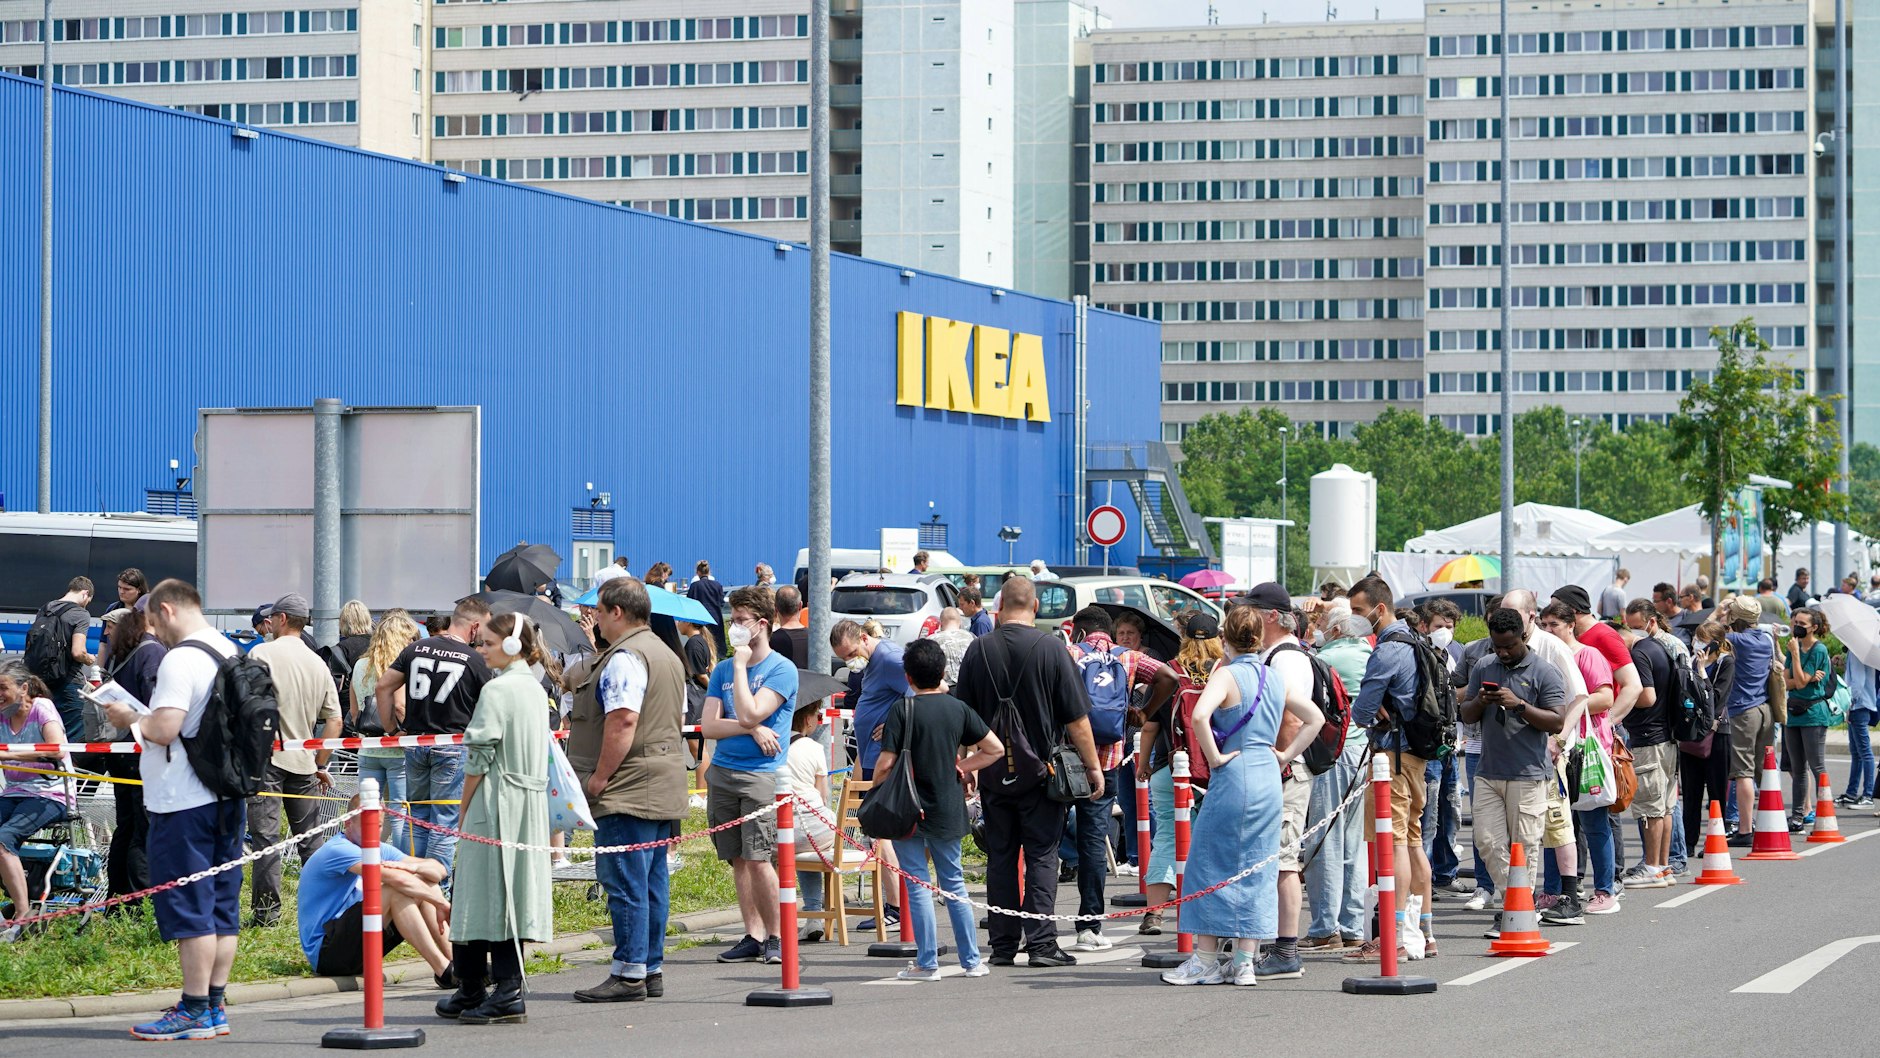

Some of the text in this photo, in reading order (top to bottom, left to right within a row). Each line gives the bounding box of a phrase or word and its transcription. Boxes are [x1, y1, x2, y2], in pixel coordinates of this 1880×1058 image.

[896, 310, 1052, 423] IKEA
[432, 648, 469, 662] KINGS
[409, 656, 466, 704] 67
